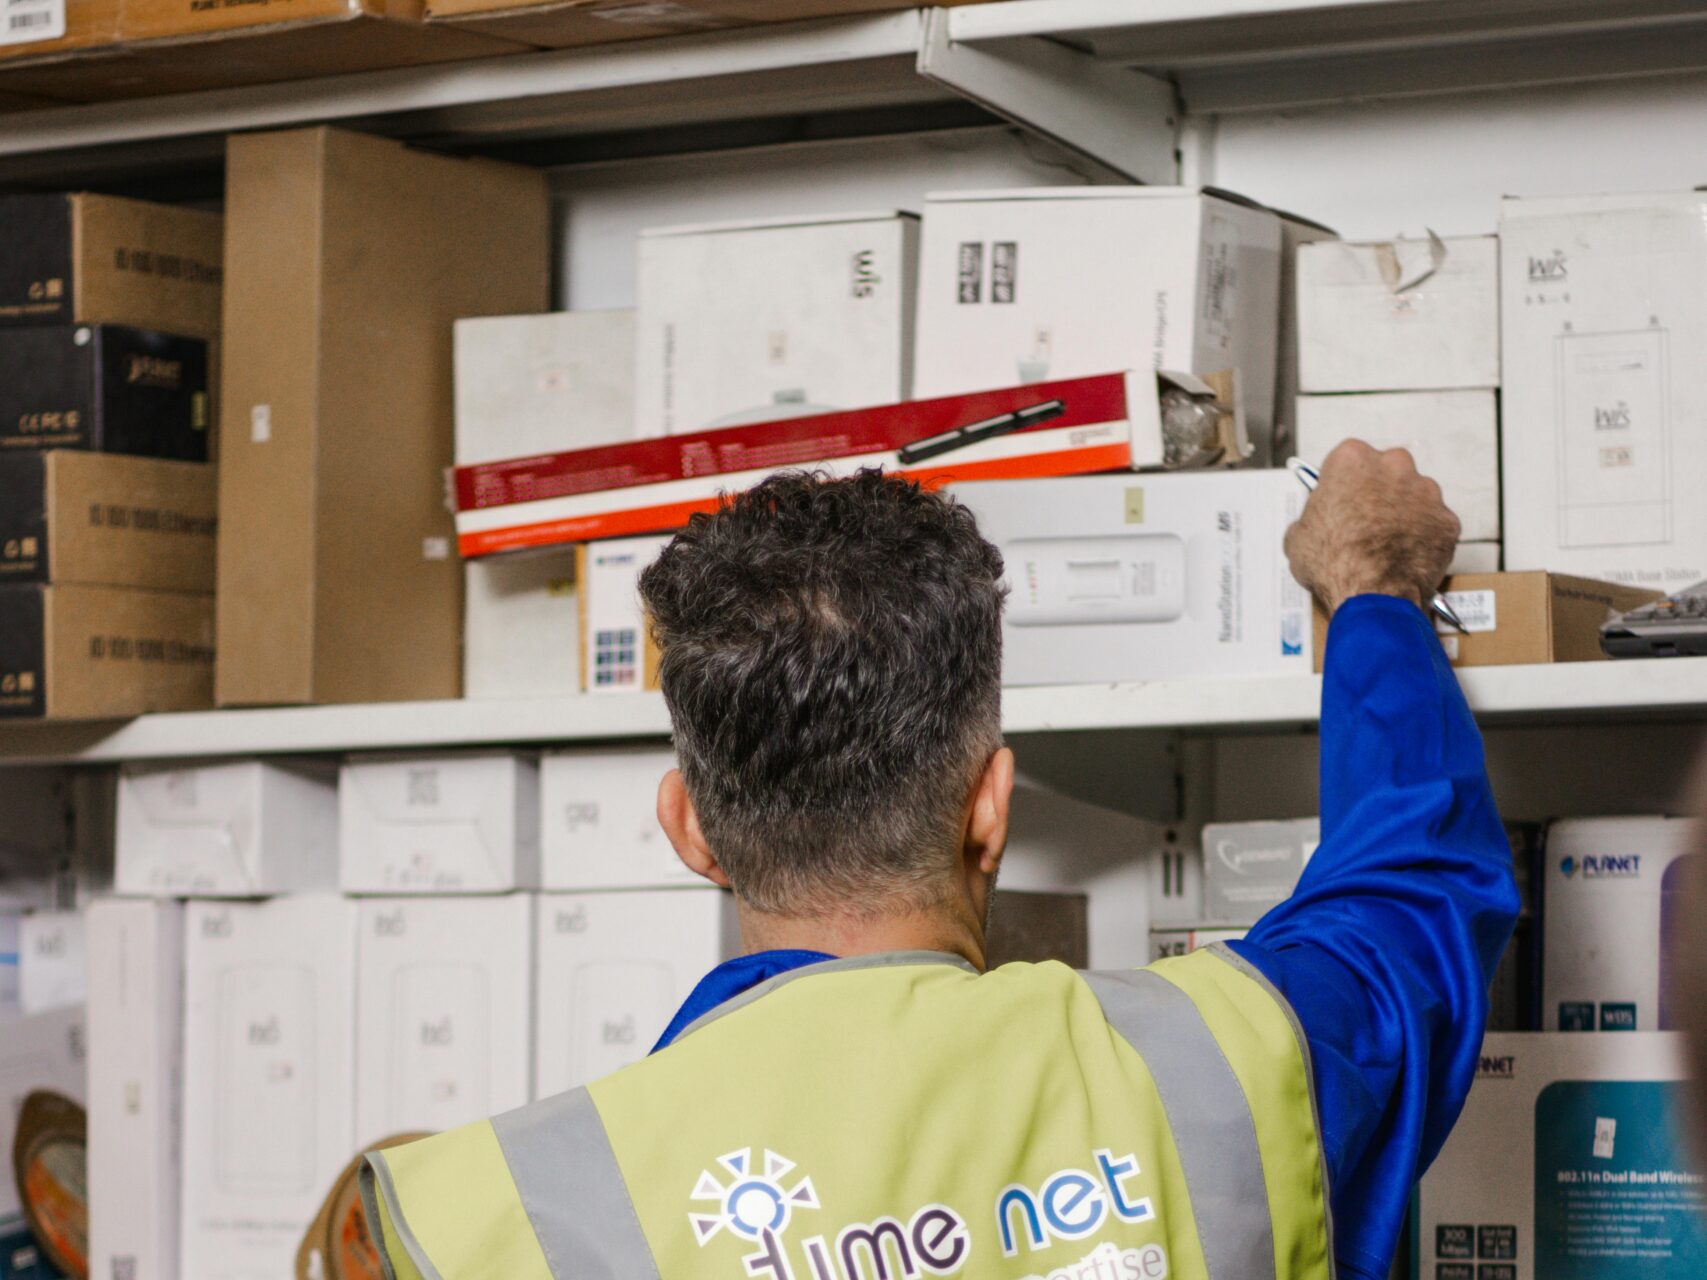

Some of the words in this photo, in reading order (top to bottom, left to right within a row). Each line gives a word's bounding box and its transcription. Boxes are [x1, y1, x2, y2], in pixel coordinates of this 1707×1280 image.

[1583, 855, 1640, 872] PLANET
[1477, 1056, 1515, 1073] ANET
[1602, 1169, 1628, 1183] Dual
[1629, 1169, 1657, 1183] Band
[997, 1152, 1150, 1252] net
